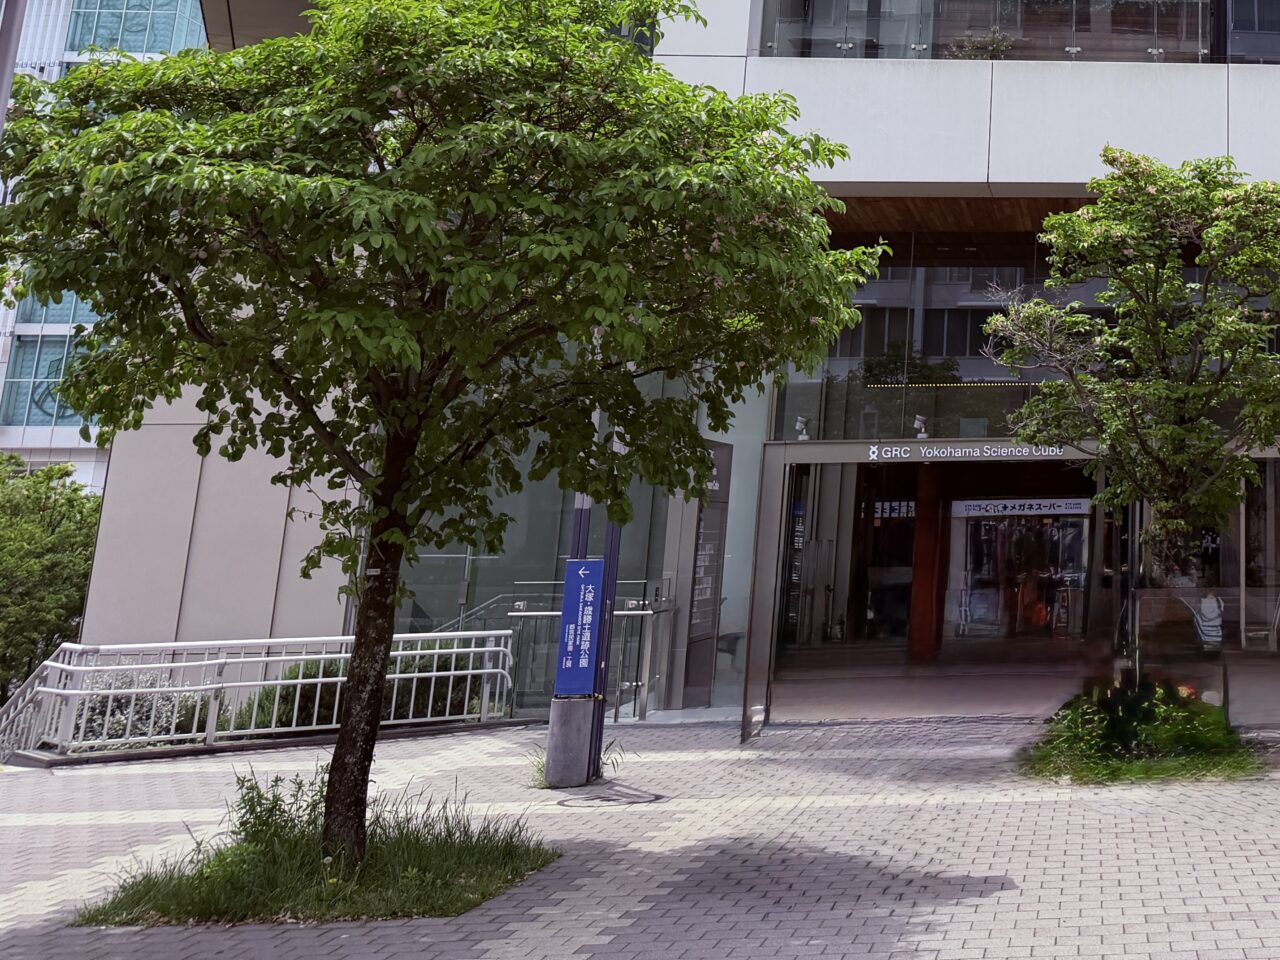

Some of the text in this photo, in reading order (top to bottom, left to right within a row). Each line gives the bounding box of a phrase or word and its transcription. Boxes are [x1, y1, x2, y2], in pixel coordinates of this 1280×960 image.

[882, 445, 1064, 458] GRC Yokohama Science Cube
[1009, 503, 1062, 512] メガネスーパー
